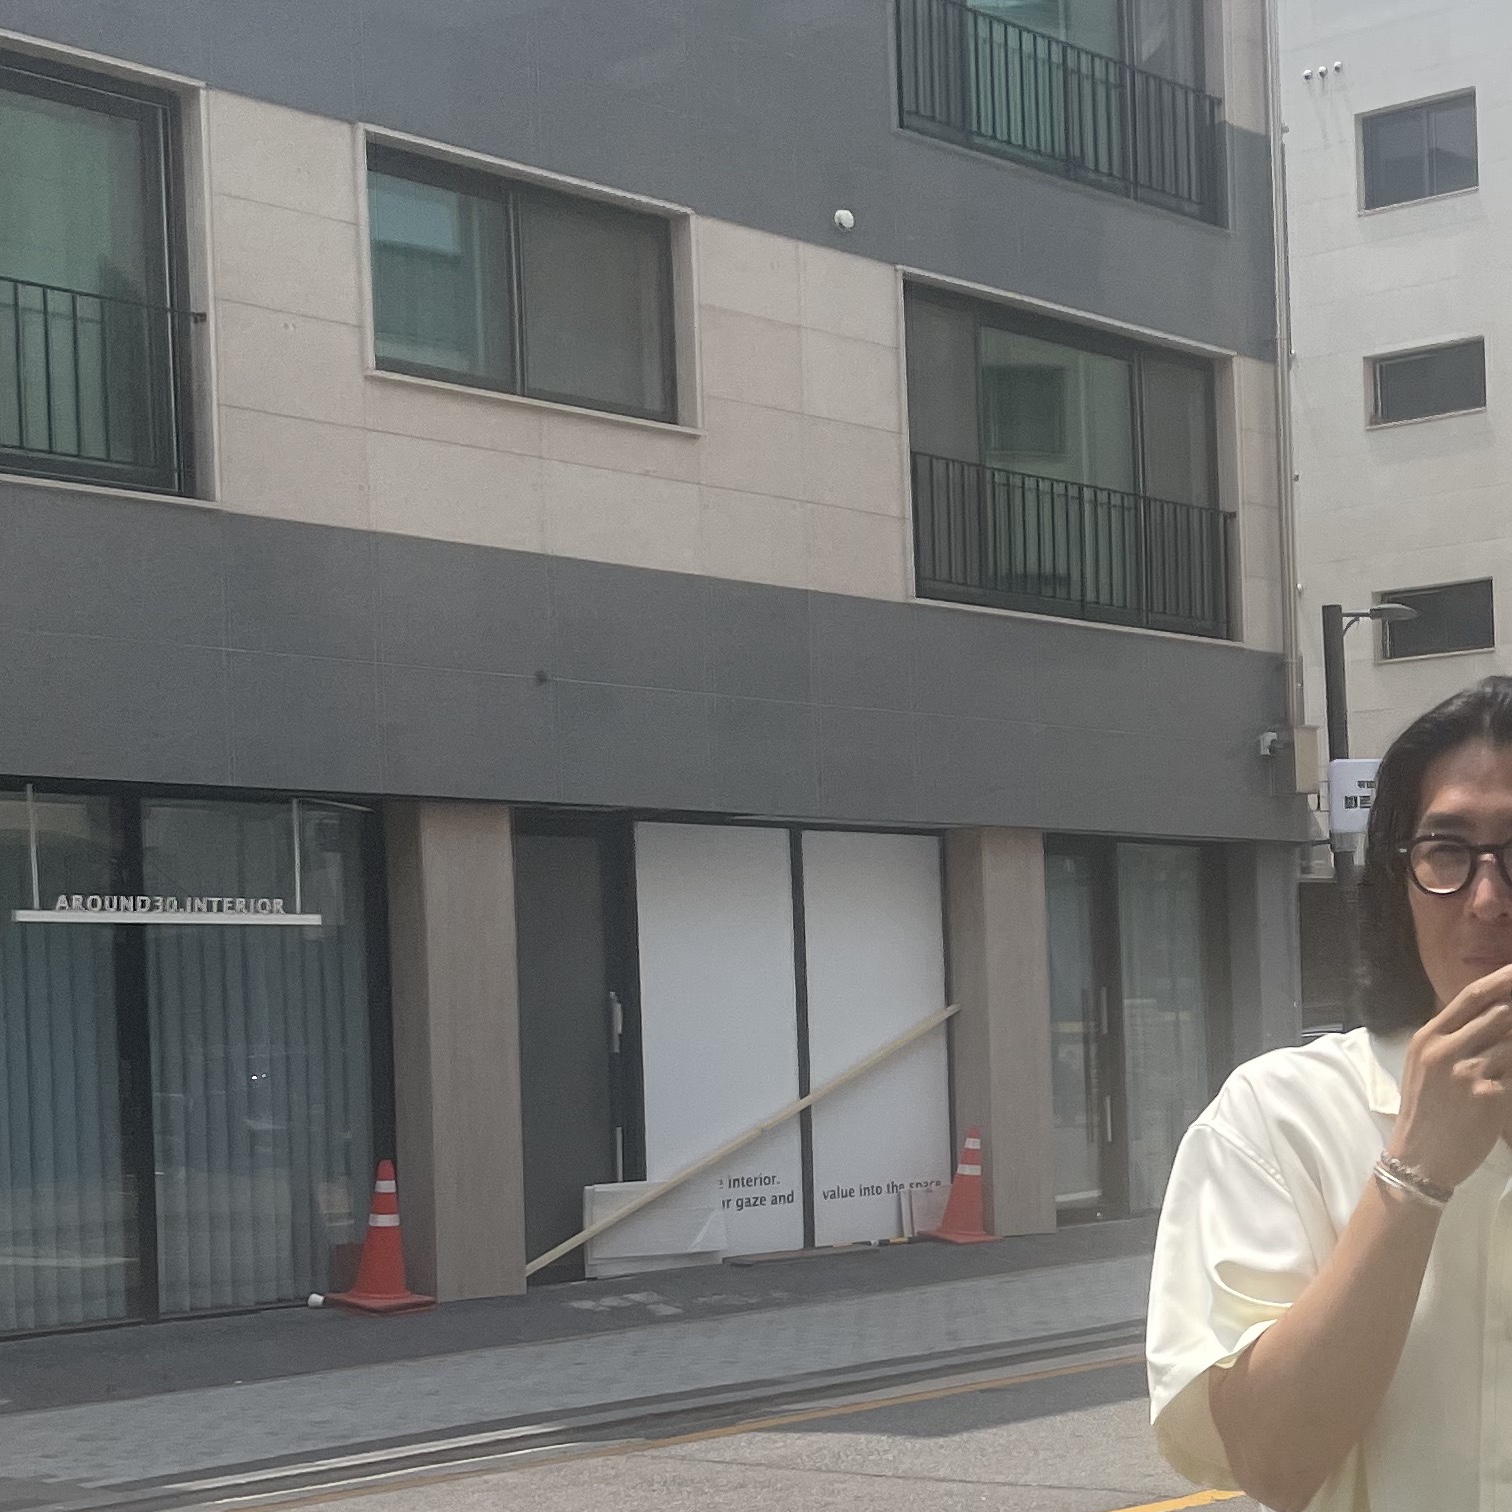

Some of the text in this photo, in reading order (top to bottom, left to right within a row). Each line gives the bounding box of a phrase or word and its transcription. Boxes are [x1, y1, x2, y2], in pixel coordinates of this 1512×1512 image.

[735, 1195, 767, 1212] gaze
[770, 1189, 795, 1206] and
[822, 1185, 856, 1201] value
[859, 1183, 883, 1197] into
